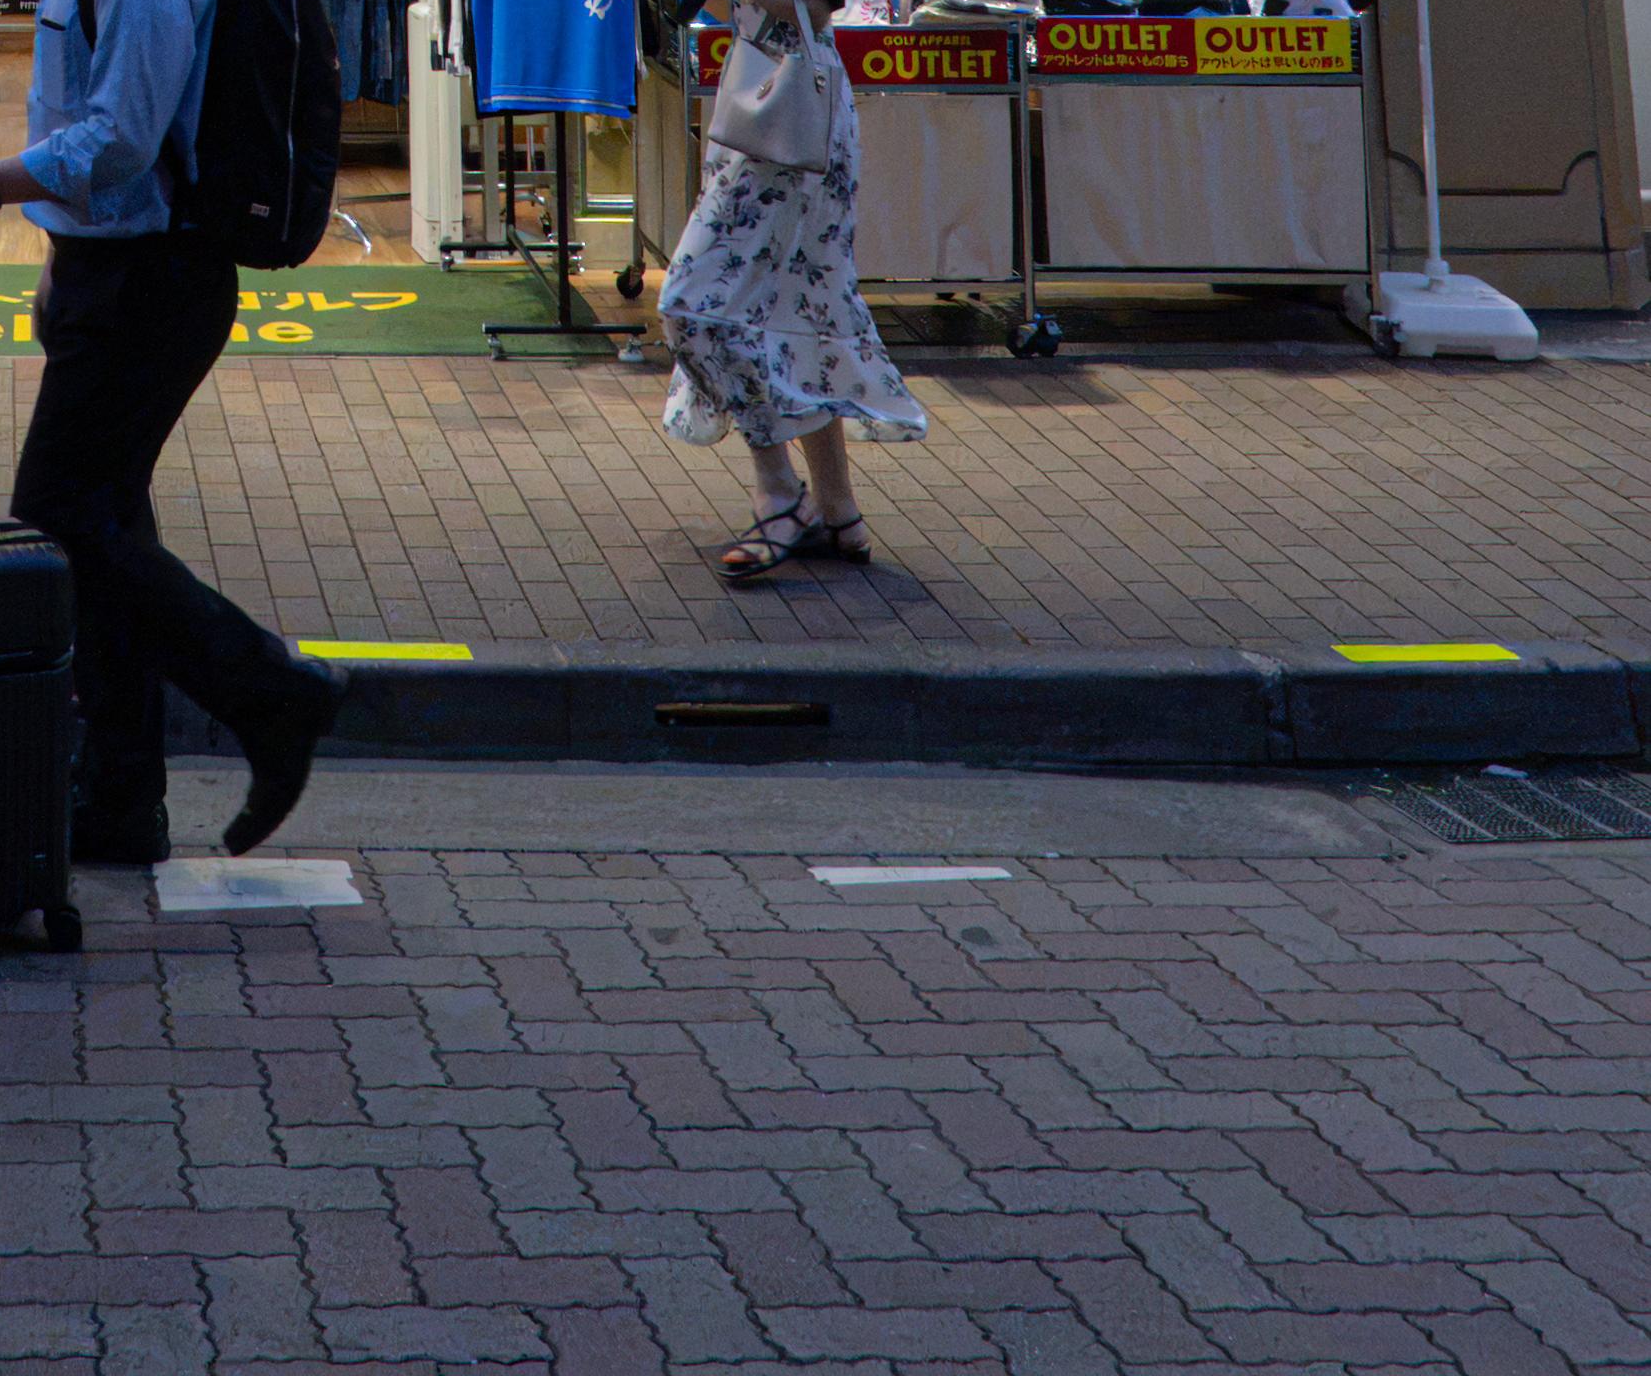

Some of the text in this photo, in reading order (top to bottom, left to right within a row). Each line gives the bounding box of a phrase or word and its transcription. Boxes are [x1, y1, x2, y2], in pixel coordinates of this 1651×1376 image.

[884, 35, 972, 46] GOLF APPAREL
[1048, 23, 1172, 51] OUTLET
[1205, 26, 1329, 53] OUTLET
[862, 49, 996, 80] OUTLET
